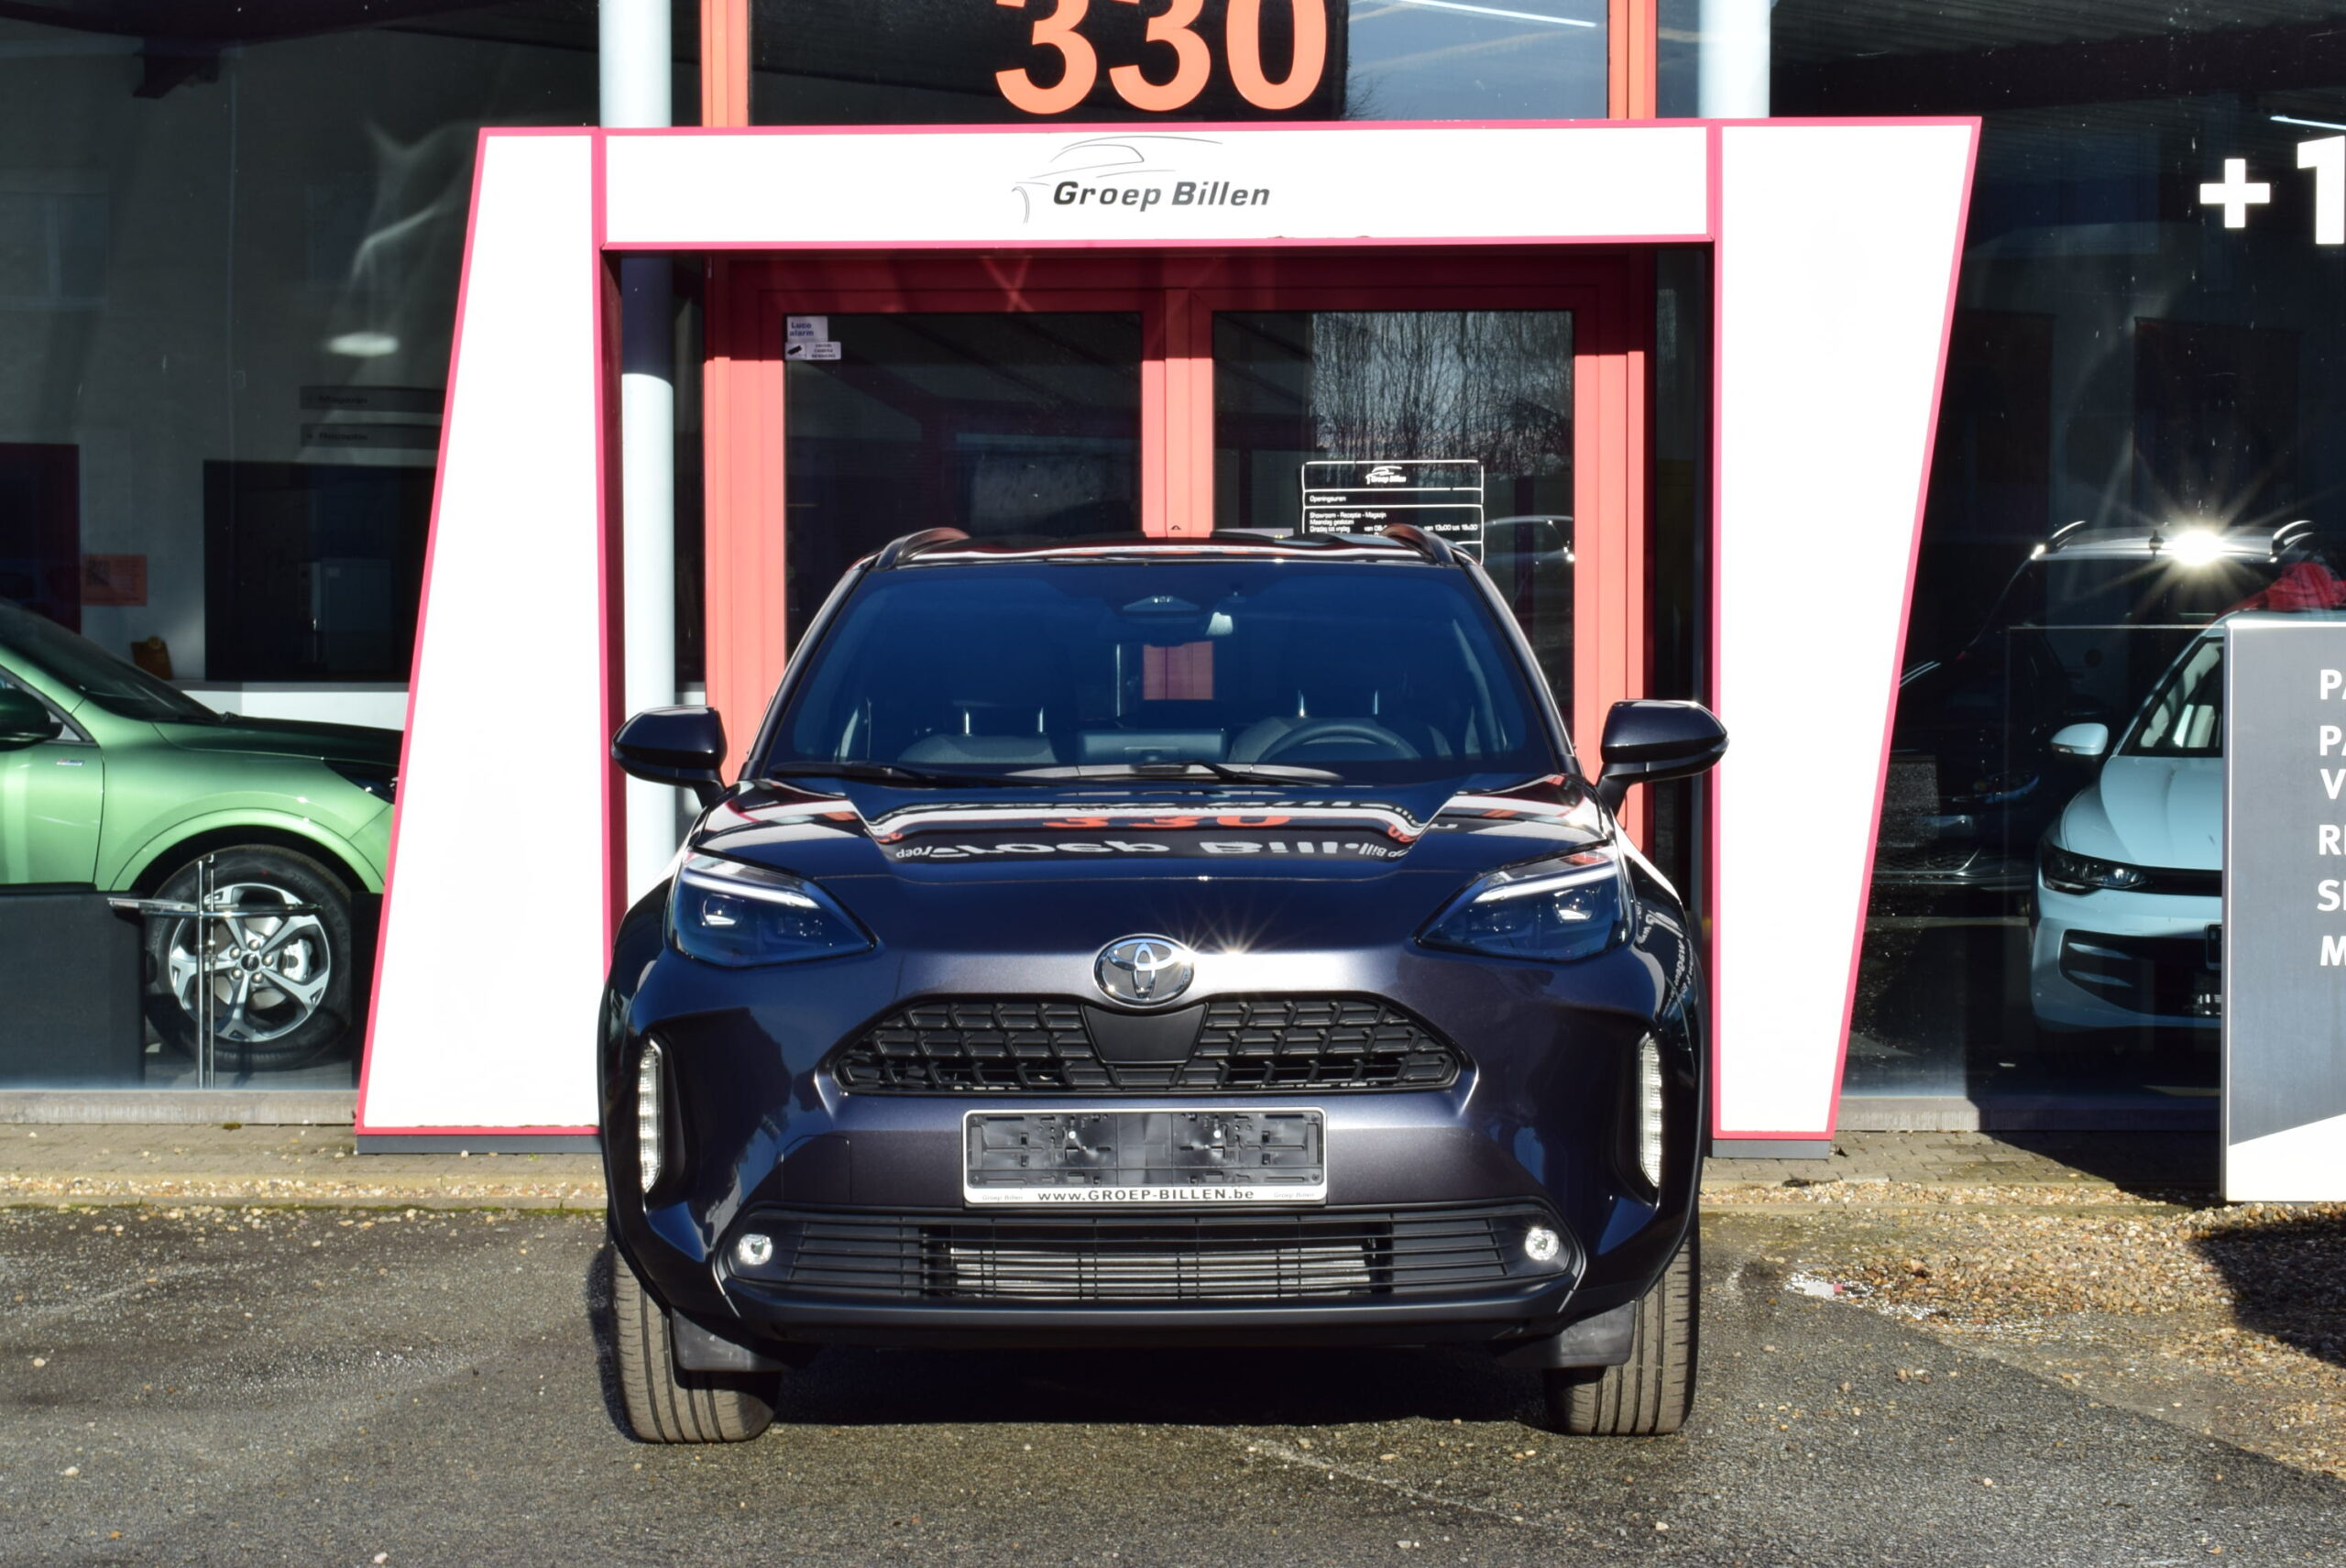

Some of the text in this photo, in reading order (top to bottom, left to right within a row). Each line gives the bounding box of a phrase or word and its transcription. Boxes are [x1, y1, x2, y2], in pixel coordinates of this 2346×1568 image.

[995, 0, 1327, 115] 330
[1053, 181, 1271, 213] Groep Billen
[790, 329, 815, 337] alarm
[2320, 669, 2346, 700] P
[2319, 725, 2346, 756] P
[2319, 824, 2346, 855] R
[2317, 879, 2346, 911] S
[1037, 1189, 1255, 1201] www.GROEP-BILLEN.be
